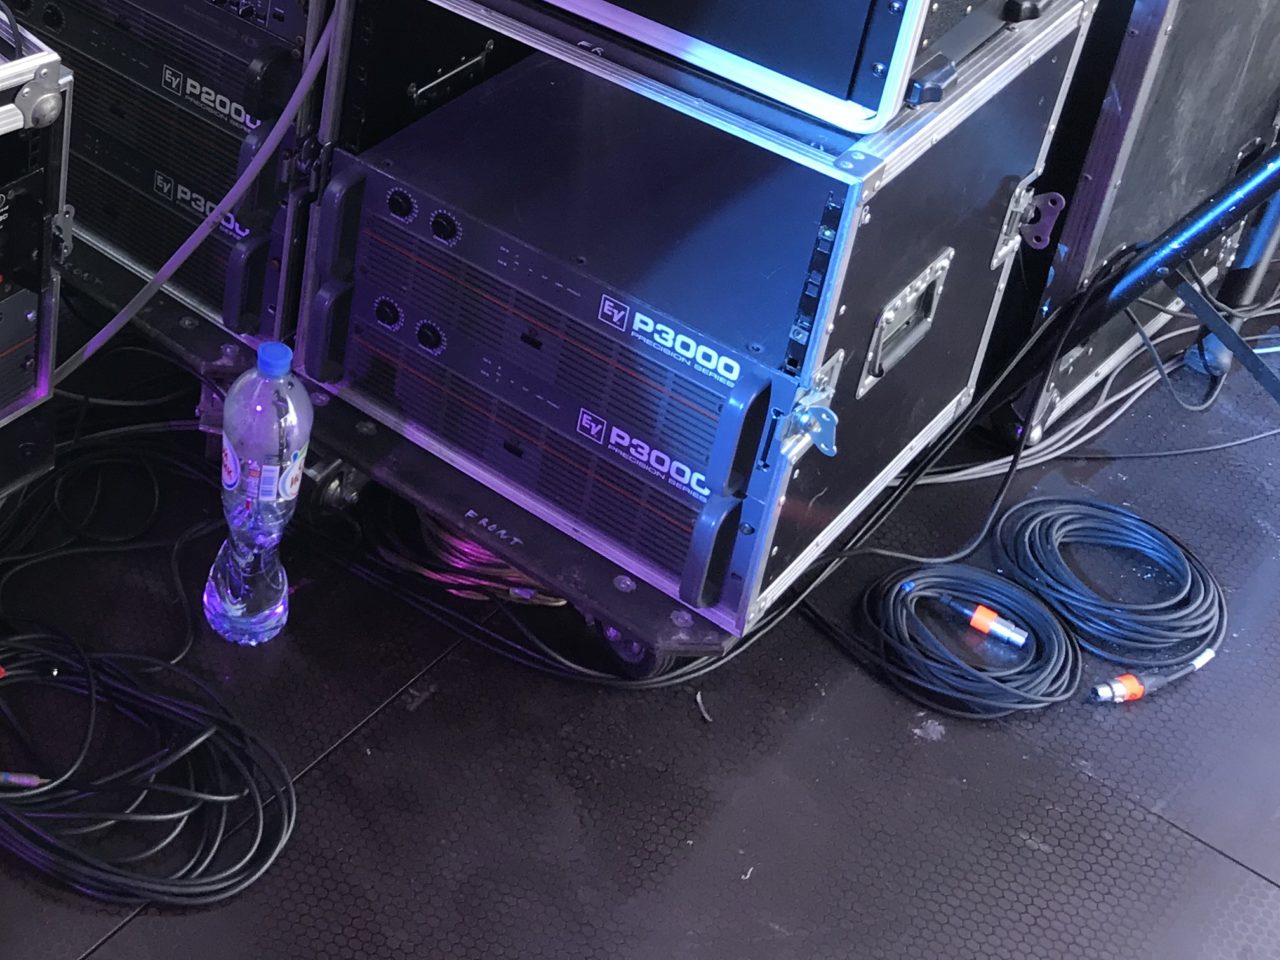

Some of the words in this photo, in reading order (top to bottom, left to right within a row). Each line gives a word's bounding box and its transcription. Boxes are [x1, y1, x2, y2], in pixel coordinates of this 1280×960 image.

[600, 297, 628, 328] EV
[632, 311, 740, 381] P3000
[630, 330, 691, 367] PRECISION
[693, 362, 736, 388] SERIES
[579, 411, 605, 441] EV
[607, 443, 667, 480] PRECISION
[668, 477, 709, 504] SERIES
[464, 508, 524, 545] FRONT
